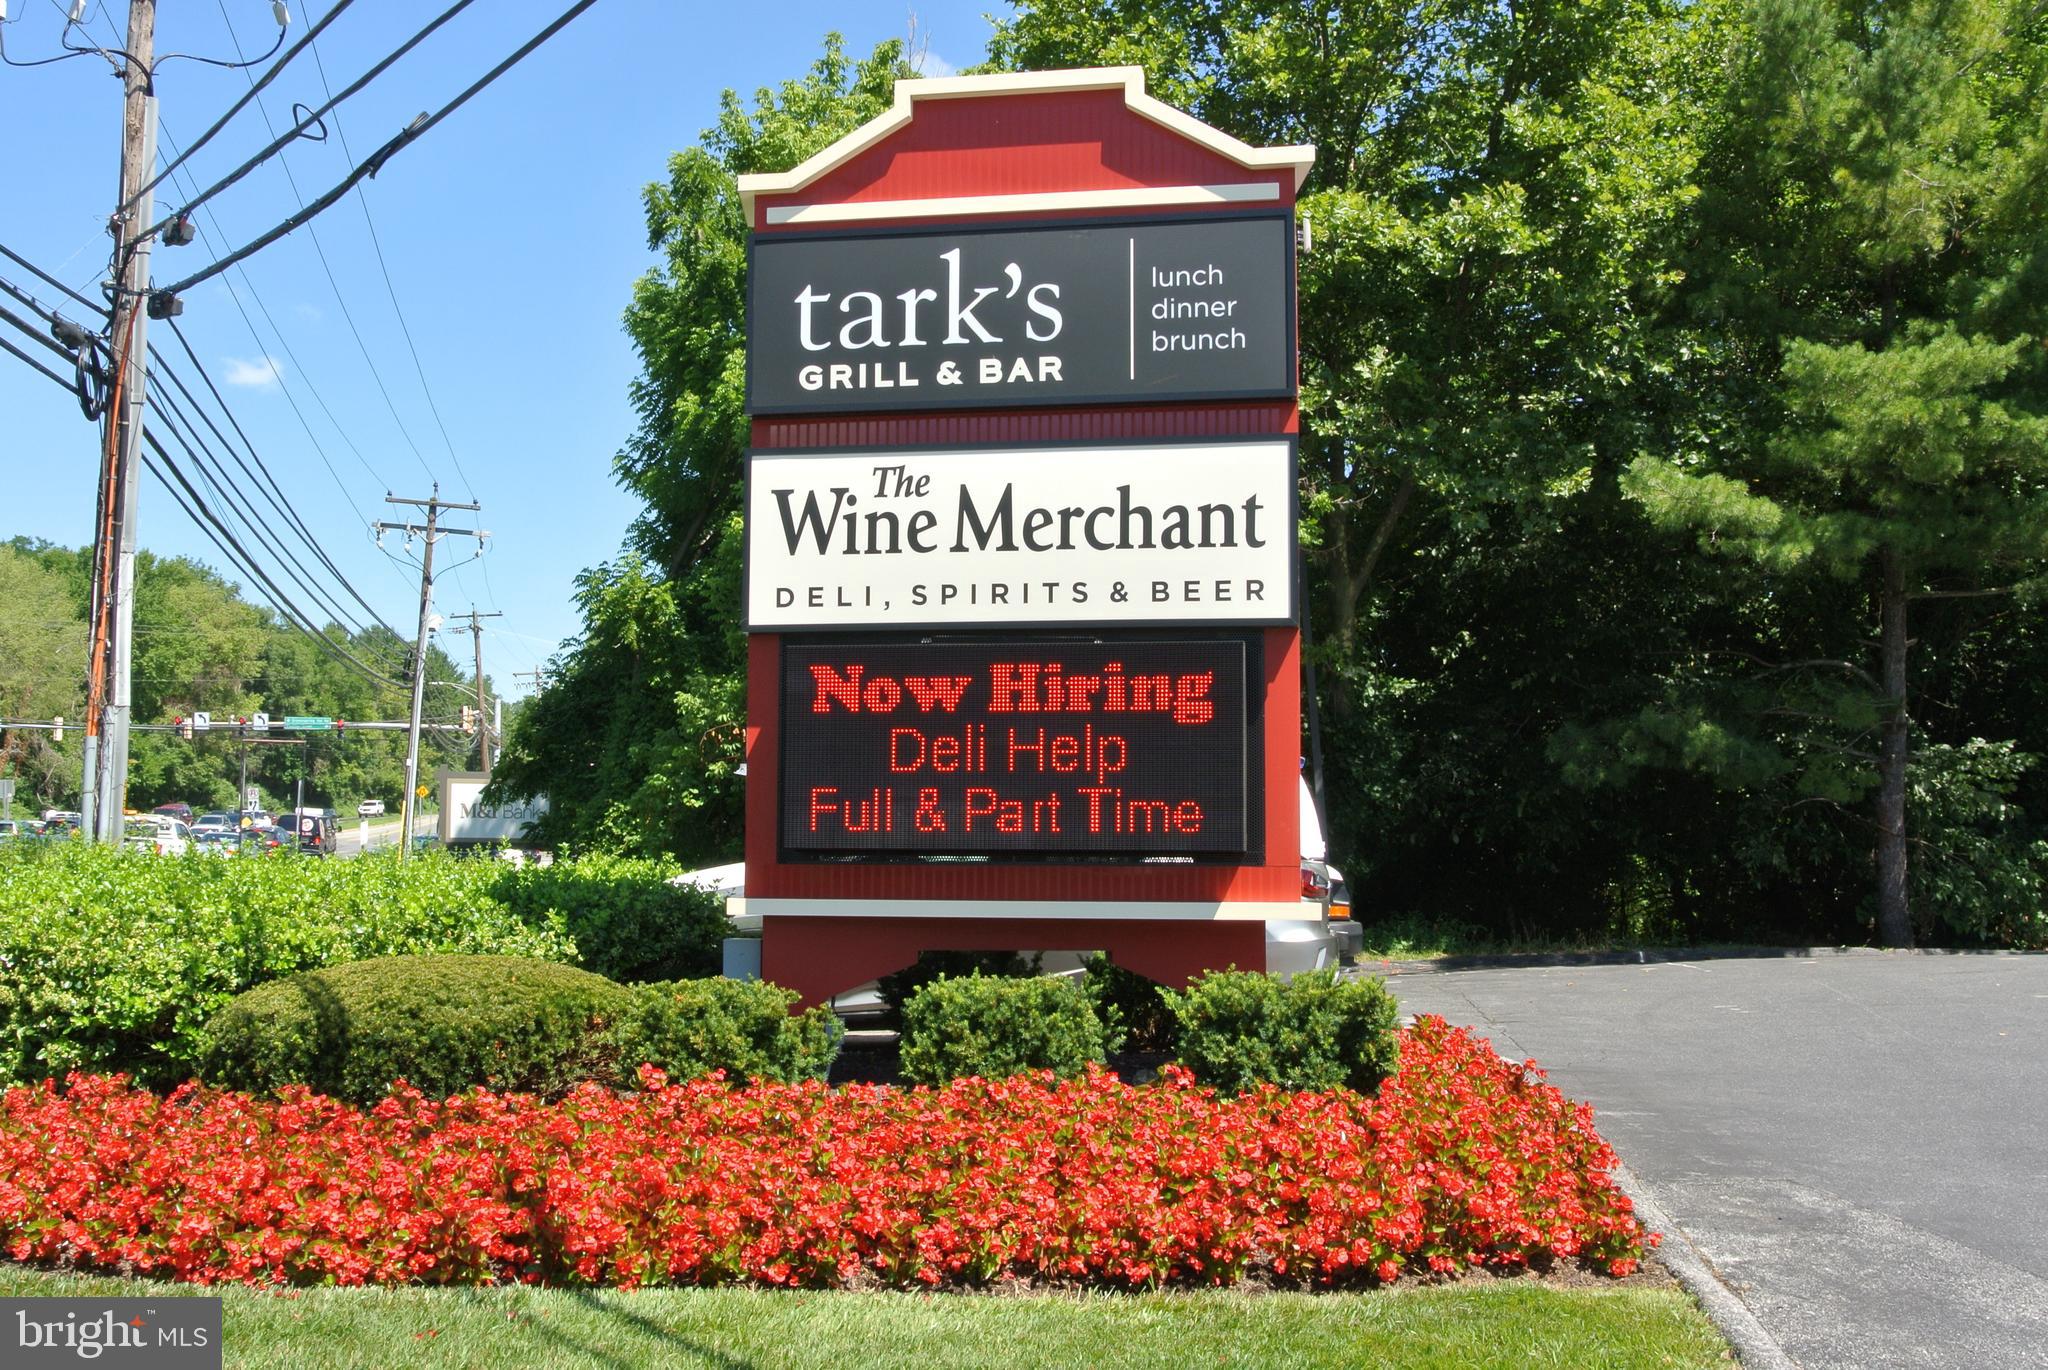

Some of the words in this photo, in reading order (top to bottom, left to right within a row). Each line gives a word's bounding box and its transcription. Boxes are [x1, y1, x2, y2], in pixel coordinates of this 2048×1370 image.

[1152, 264, 1223, 288] lunch
[793, 247, 1063, 352] tark's
[1151, 297, 1238, 320] dinner
[1152, 327, 1246, 352] brunch
[798, 362, 920, 391] GRILL
[936, 360, 964, 386] &
[979, 355, 1064, 384] BAR
[873, 464, 931, 498] The
[771, 486, 938, 556] Wine
[949, 482, 1266, 553] Merchant
[776, 586, 891, 611] DELI,
[911, 581, 1089, 606] SPIRITS
[1109, 581, 1130, 603] &
[1151, 579, 1265, 603] BEER
[809, 665, 972, 713] Now
[988, 662, 1214, 725] Hiring
[890, 723, 985, 773] Deli
[1008, 723, 1127, 784] Help
[810, 787, 893, 833] Full
[914, 787, 946, 833] &
[965, 787, 1061, 833] Part
[1077, 786, 1204, 833] Time
